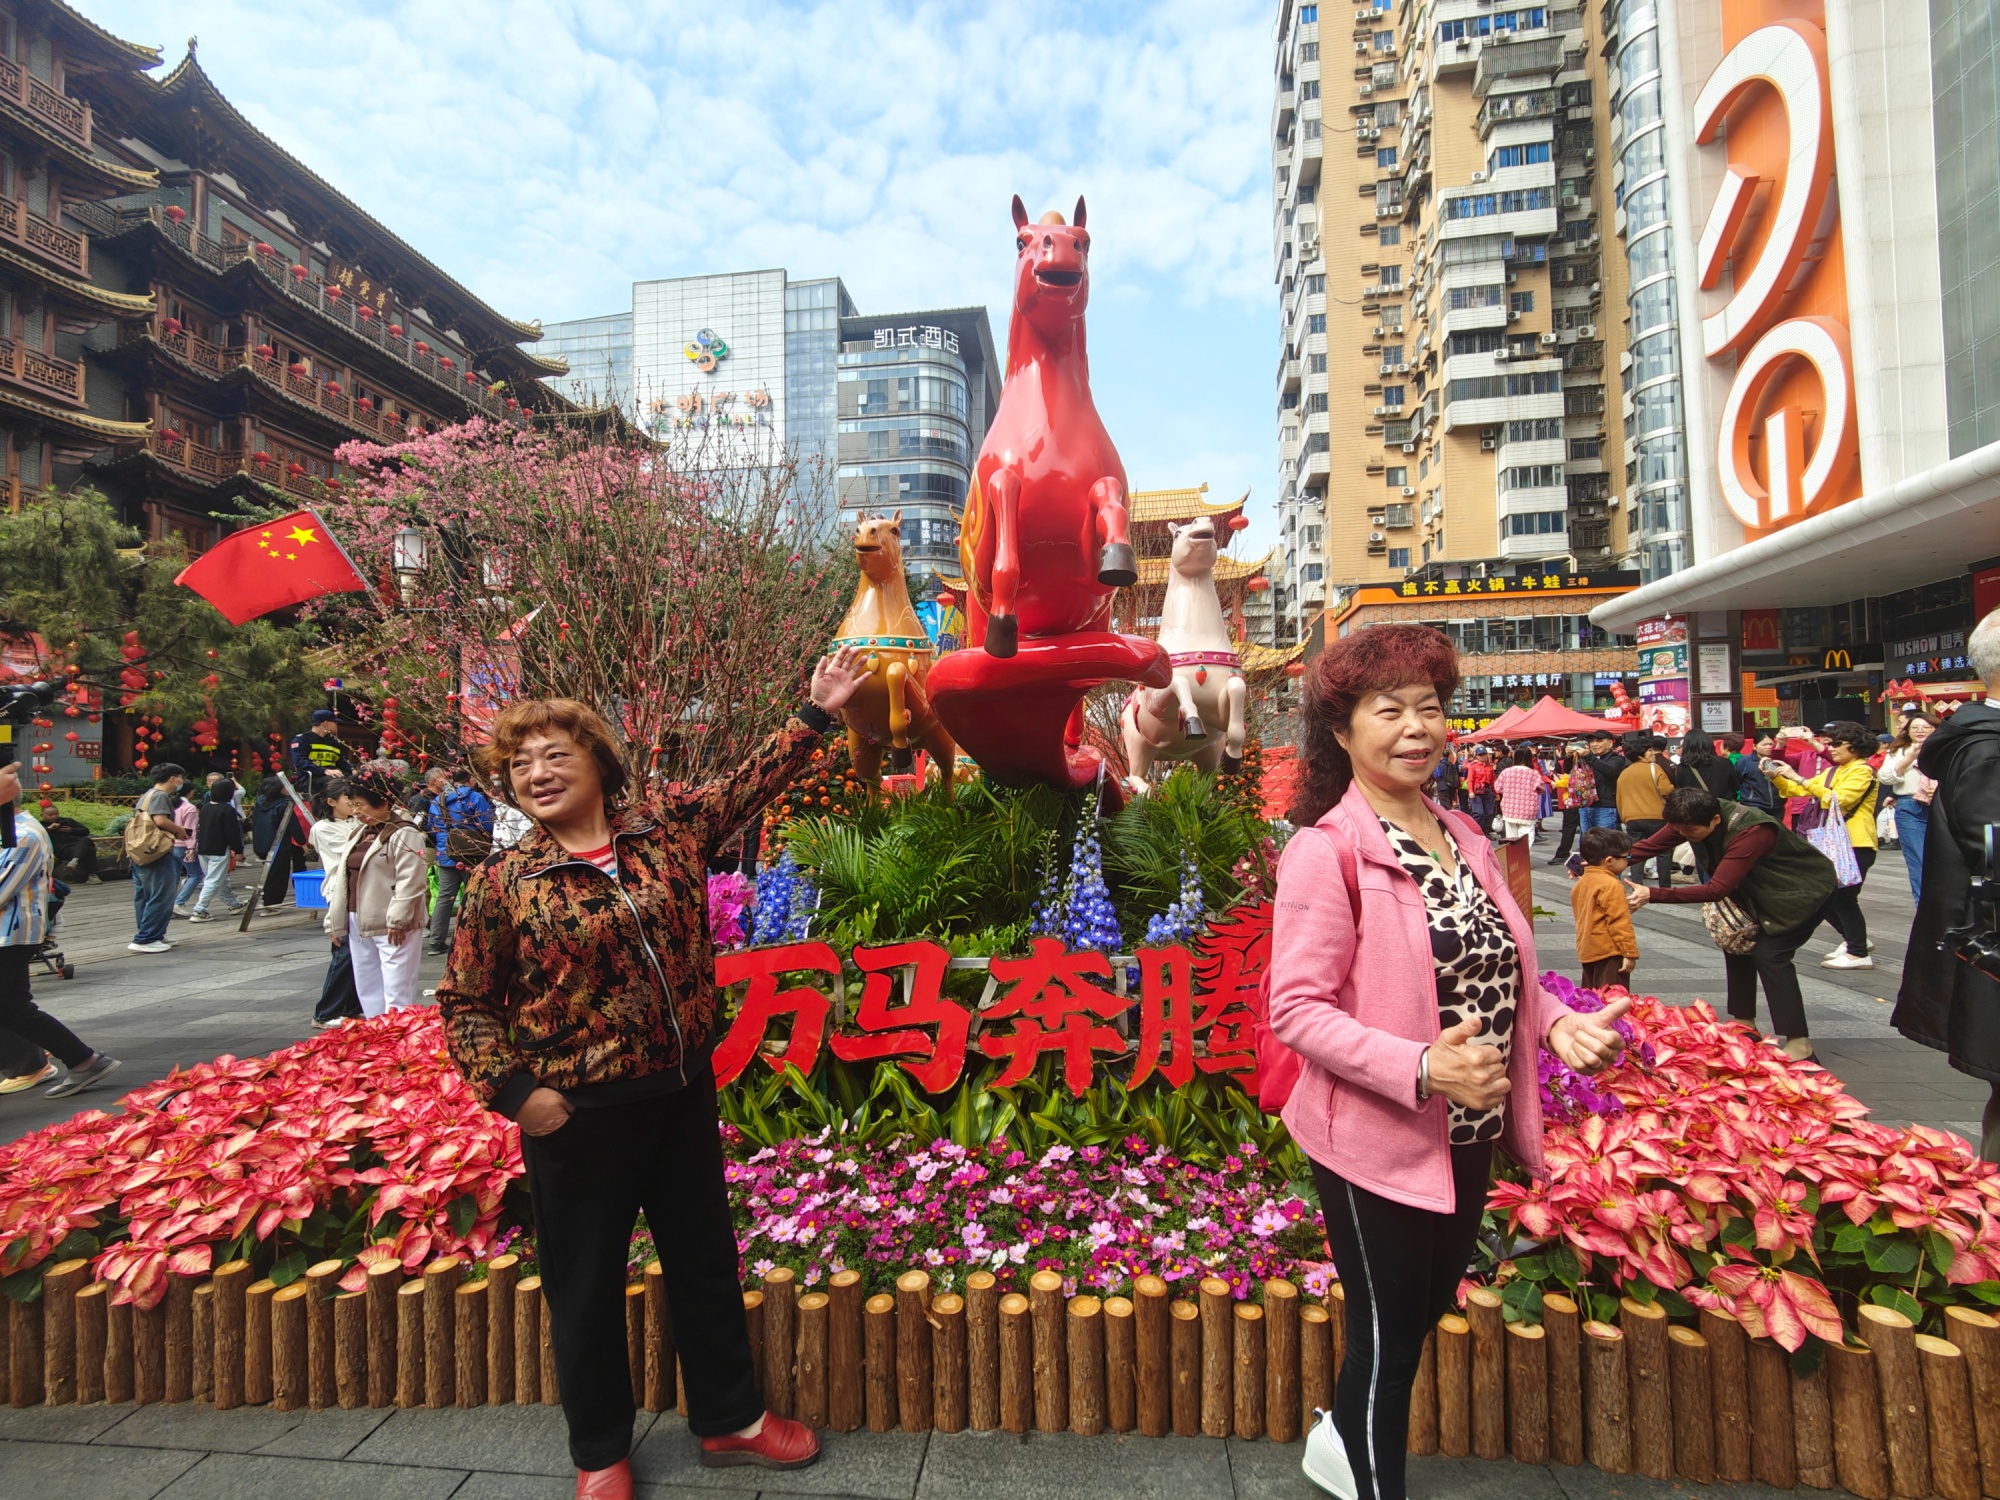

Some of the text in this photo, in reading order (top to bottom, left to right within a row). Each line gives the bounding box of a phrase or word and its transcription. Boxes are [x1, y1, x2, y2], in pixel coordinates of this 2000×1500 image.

[1894, 632, 1965, 657] INSHOW 迎秀
[1492, 674, 1562, 688] 港式茶餐厅
[1707, 706, 1722, 714] 9%
[712, 903, 1263, 1100] 万马奔腾
